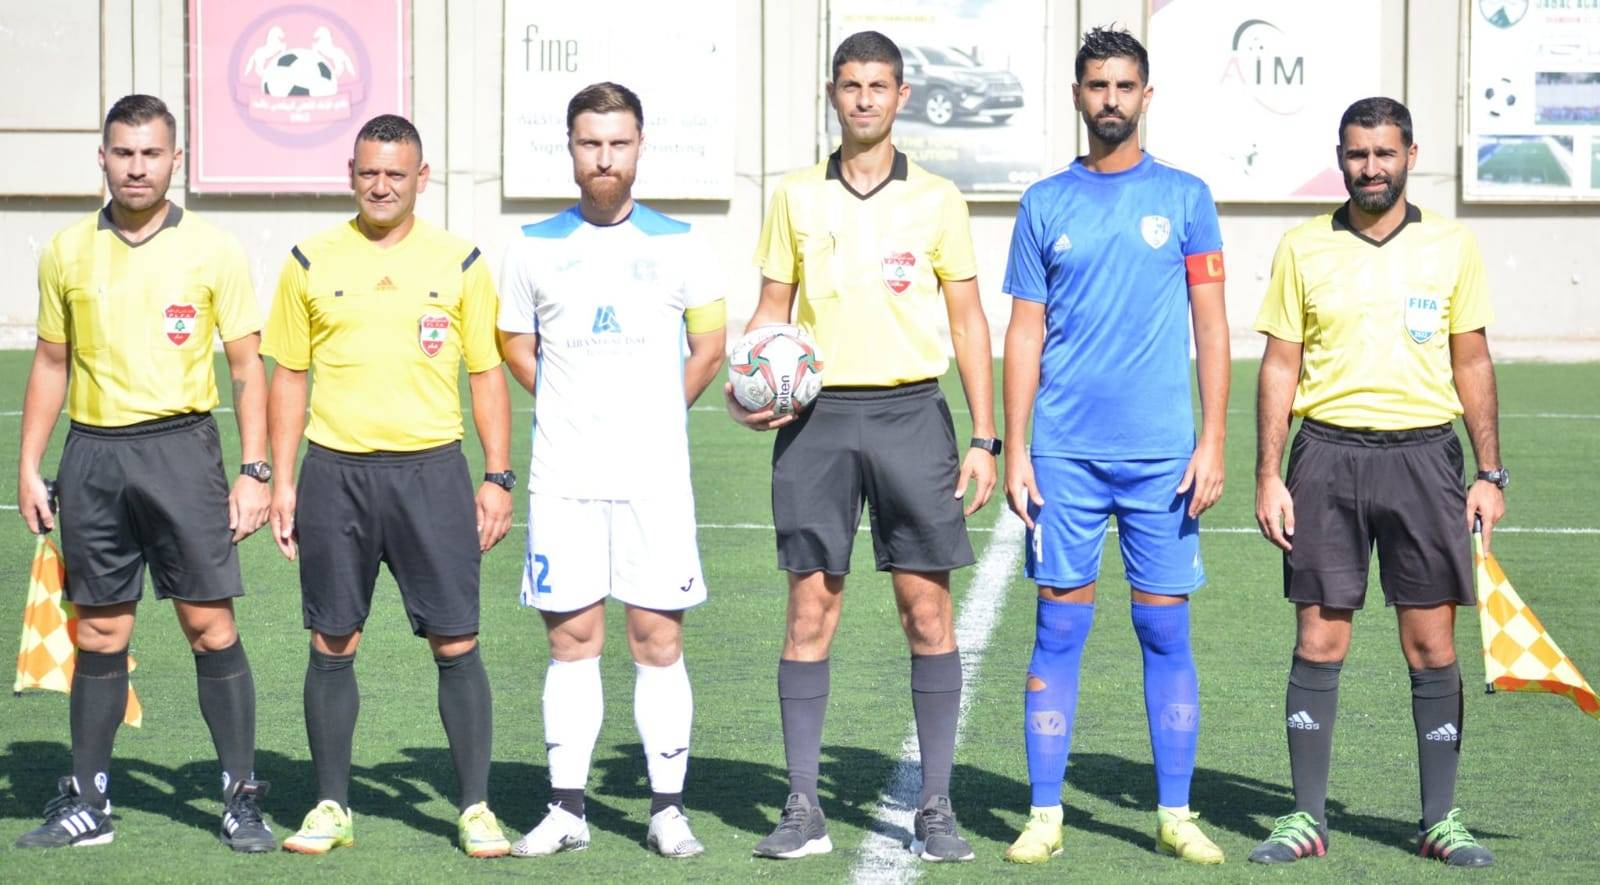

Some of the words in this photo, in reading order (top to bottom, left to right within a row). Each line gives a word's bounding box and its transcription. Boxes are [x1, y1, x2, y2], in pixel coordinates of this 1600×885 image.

[521, 24, 578, 72] fine
[1220, 55, 1304, 86] AIM
[1207, 254, 1223, 277] C
[1409, 297, 1437, 311] FIFA
[778, 375, 790, 414] molten
[1287, 719, 1320, 731] didas
[1425, 731, 1460, 742] adida
